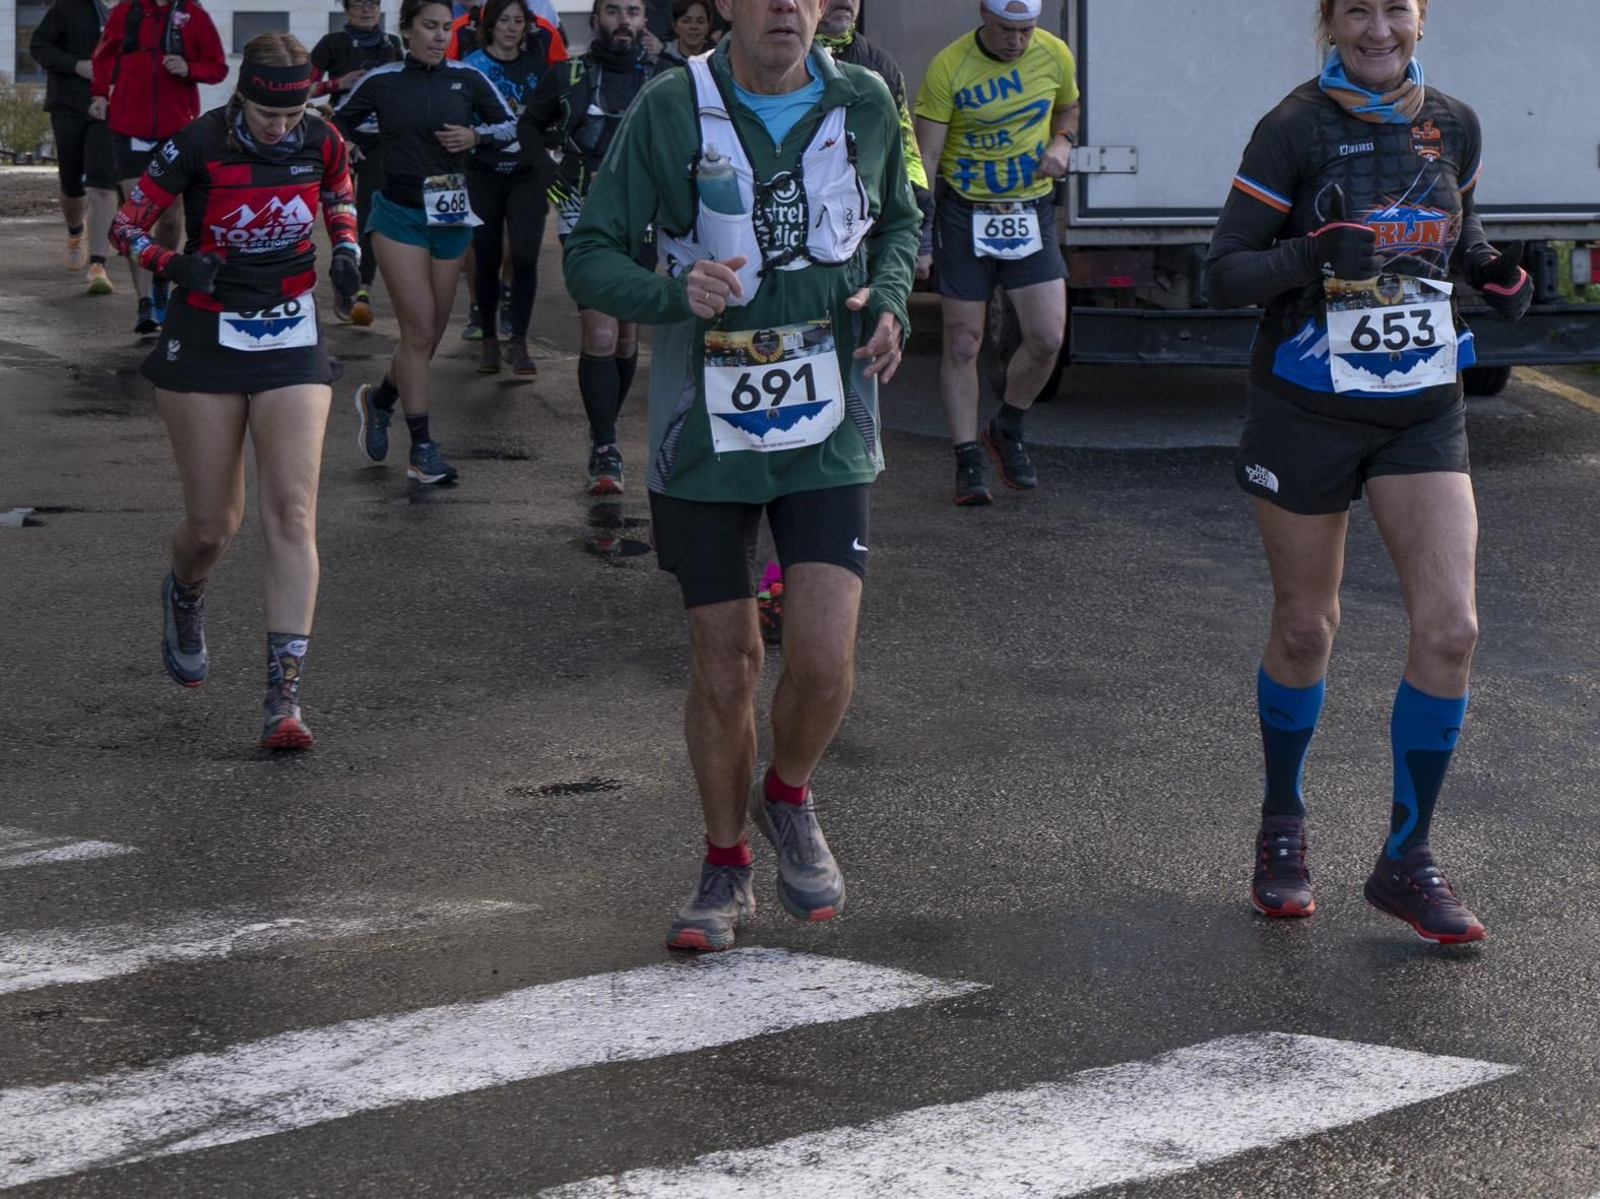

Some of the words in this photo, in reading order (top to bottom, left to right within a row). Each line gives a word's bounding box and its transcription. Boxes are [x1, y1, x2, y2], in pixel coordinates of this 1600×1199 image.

[955, 68, 1024, 109] RUN
[953, 141, 1046, 194] FUN
[435, 192, 466, 213] 668
[984, 217, 1030, 238] 685
[1369, 220, 1444, 246] RUN
[1351, 309, 1436, 352] 653
[731, 362, 817, 412] 691
